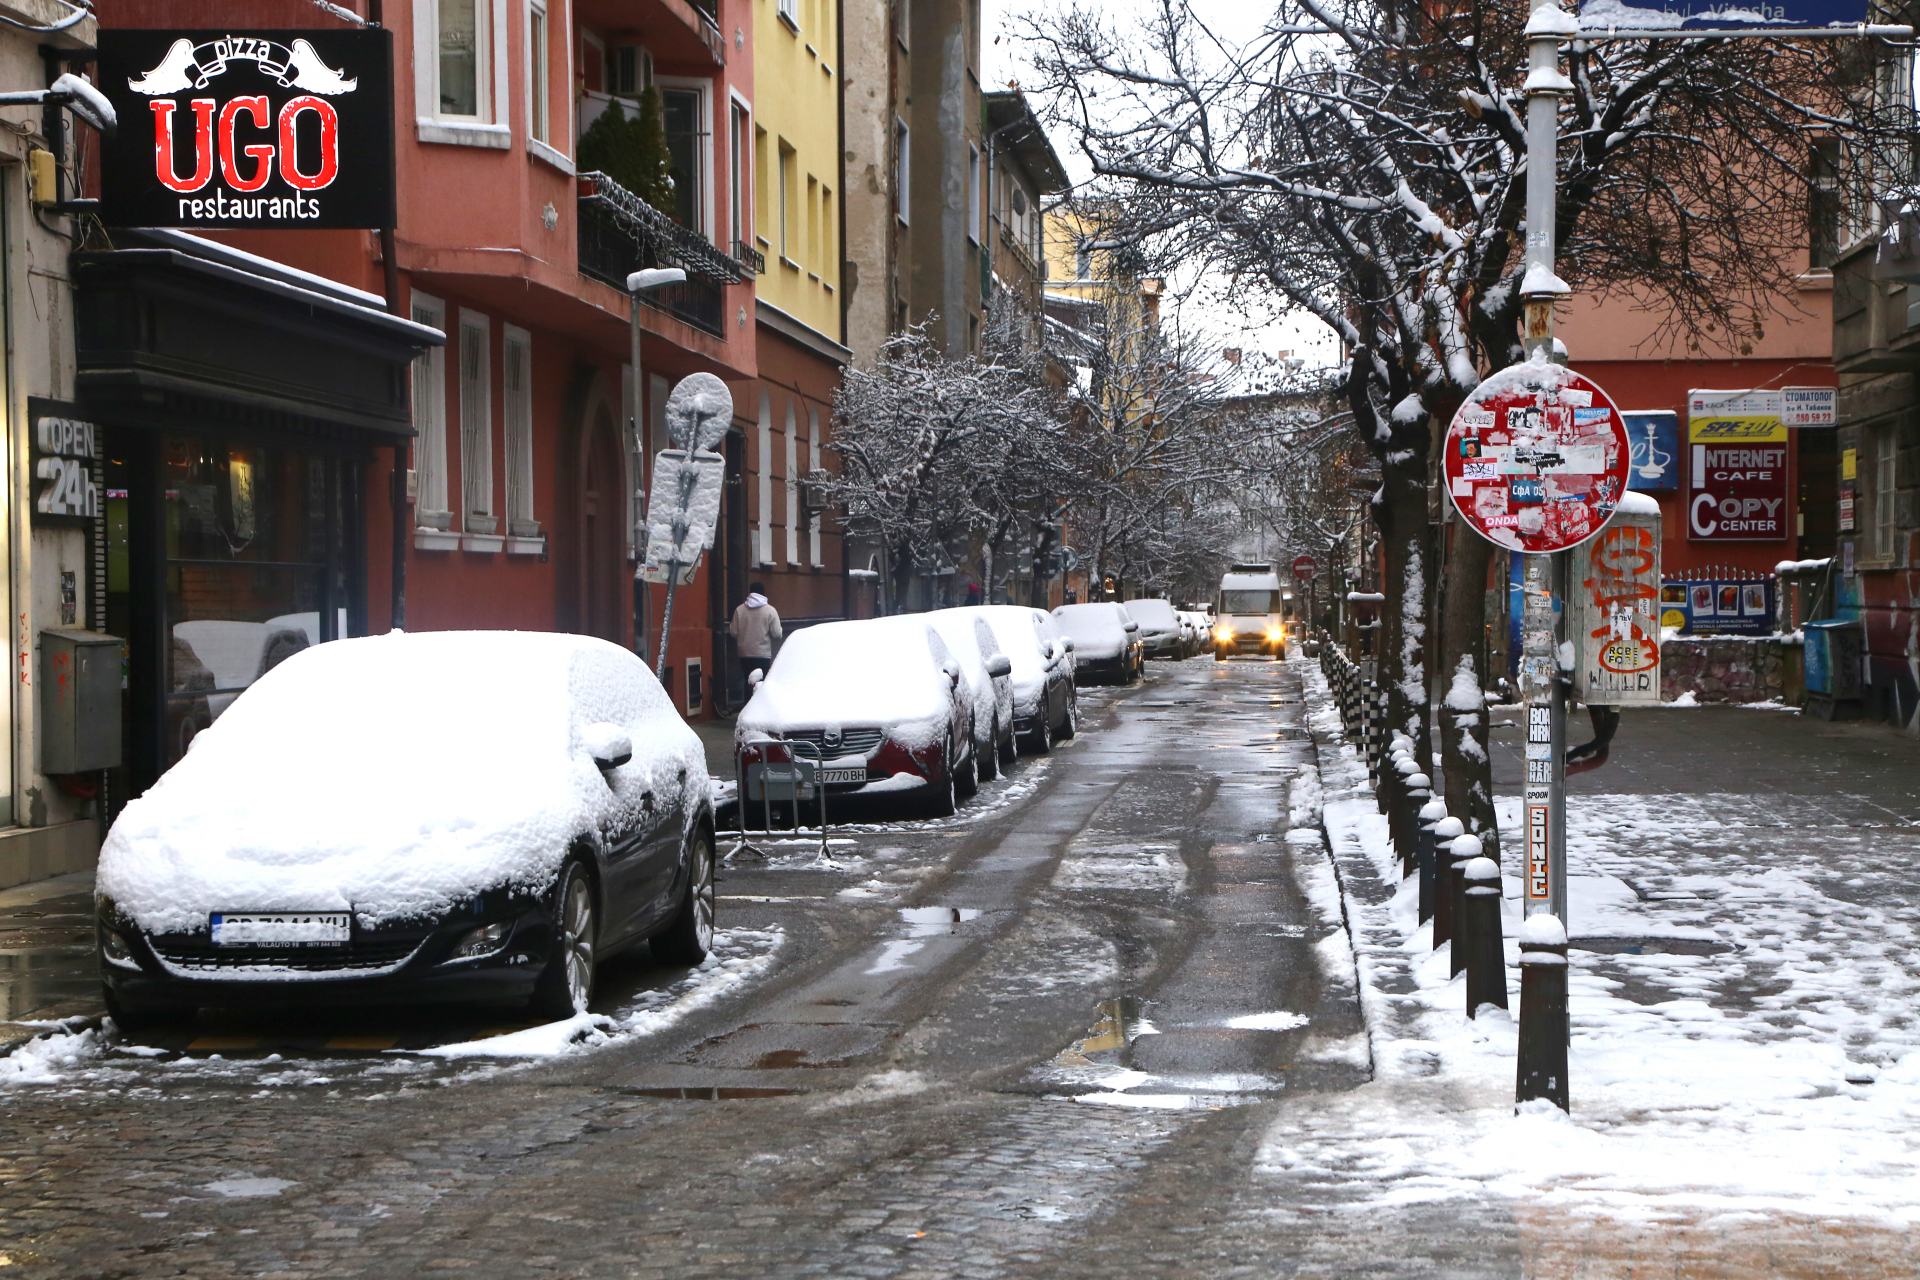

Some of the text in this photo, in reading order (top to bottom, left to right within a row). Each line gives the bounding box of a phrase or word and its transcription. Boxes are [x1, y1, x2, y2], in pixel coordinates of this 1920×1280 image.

[214, 34, 270, 62] pizza
[150, 96, 339, 193] UGO
[179, 187, 320, 219] restaurants
[1785, 392, 1833, 402] СТОМАТОЛОГ
[48, 416, 94, 458] OPEN
[1693, 445, 1785, 488] INTERNET
[1714, 471, 1772, 480] CAFE
[48, 457, 97, 517] 24h
[1486, 516, 1519, 526] ONDA
[1691, 493, 1783, 536] COPY
[1720, 521, 1776, 531] CENTER
[824, 770, 849, 781] 7770
[850, 770, 865, 780] BH
[1527, 791, 1548, 799] SPOON
[1531, 808, 1546, 895] SONIC
